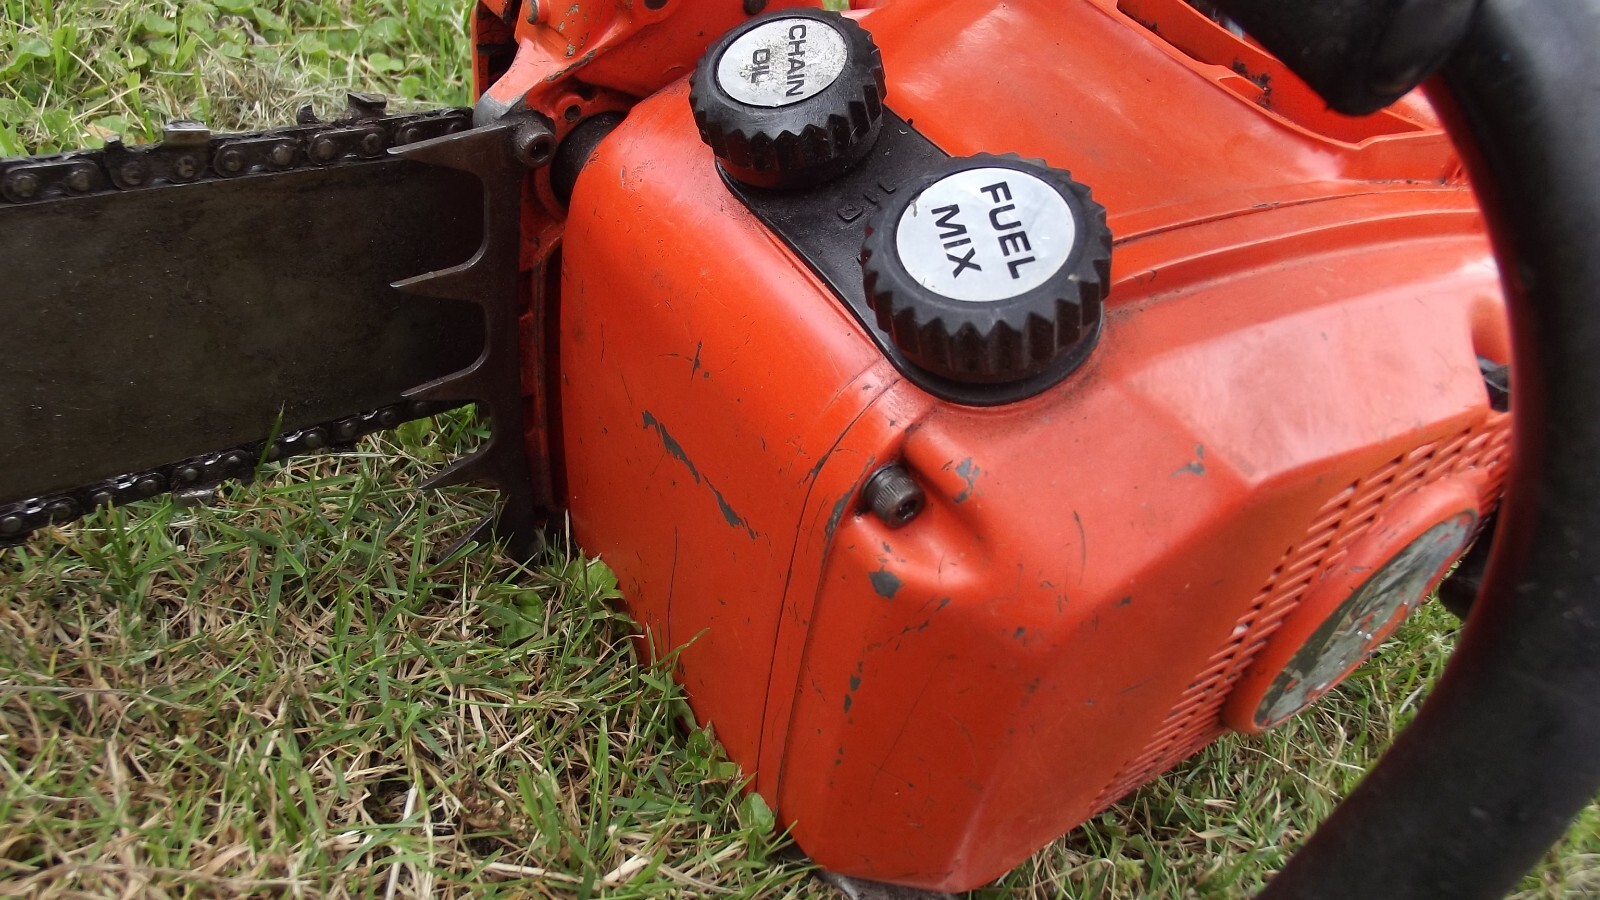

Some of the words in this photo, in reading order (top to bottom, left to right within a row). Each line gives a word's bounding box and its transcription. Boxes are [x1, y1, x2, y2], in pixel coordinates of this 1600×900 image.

[751, 49, 770, 84] OIL
[786, 24, 807, 97] CHAIN
[931, 204, 982, 279] MIX
[980, 181, 1036, 279] FUEL
